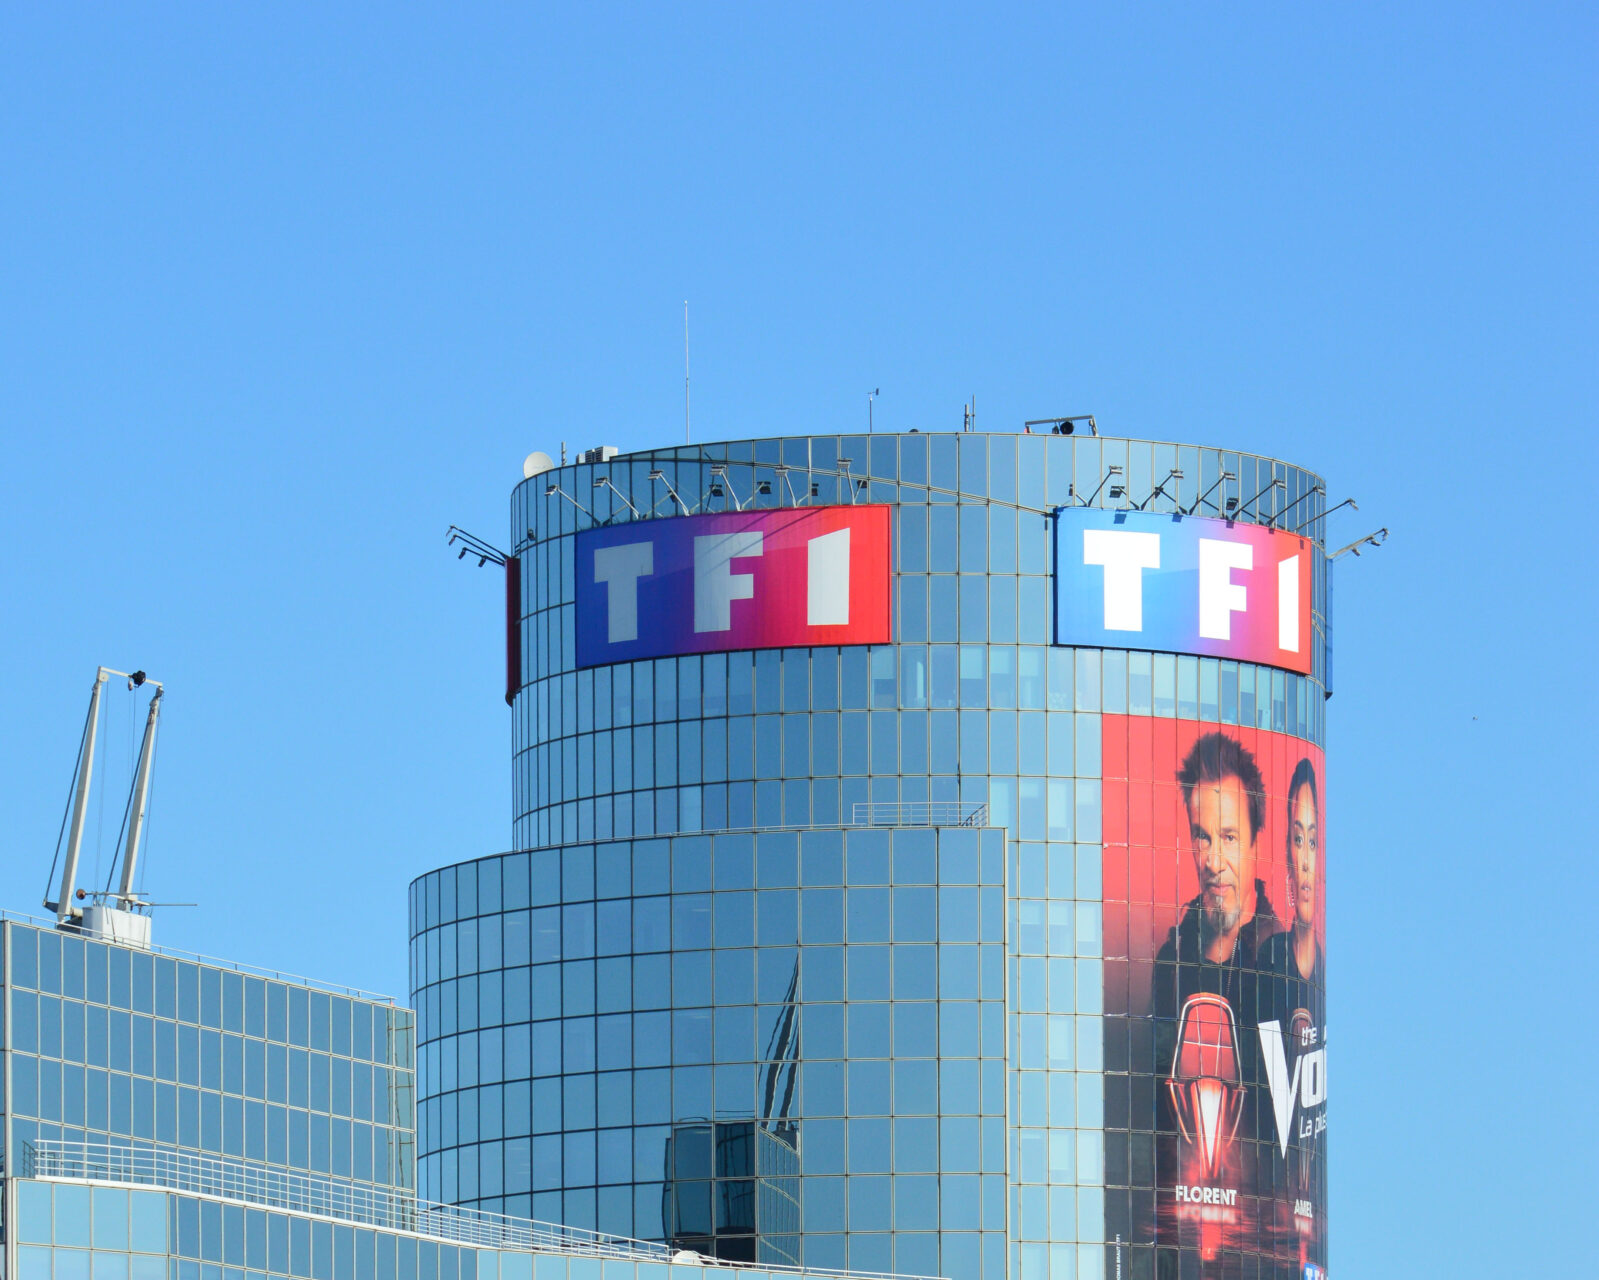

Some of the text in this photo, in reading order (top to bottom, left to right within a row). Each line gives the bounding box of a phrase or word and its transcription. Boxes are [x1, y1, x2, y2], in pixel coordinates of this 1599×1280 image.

[594, 527, 850, 643] TF1
[1084, 529, 1299, 653] TF1
[1302, 1026, 1317, 1046] the
[1300, 1115, 1312, 1138] La
[1176, 1185, 1237, 1205] FLORENT
[1294, 1199, 1312, 1218] AMEL
